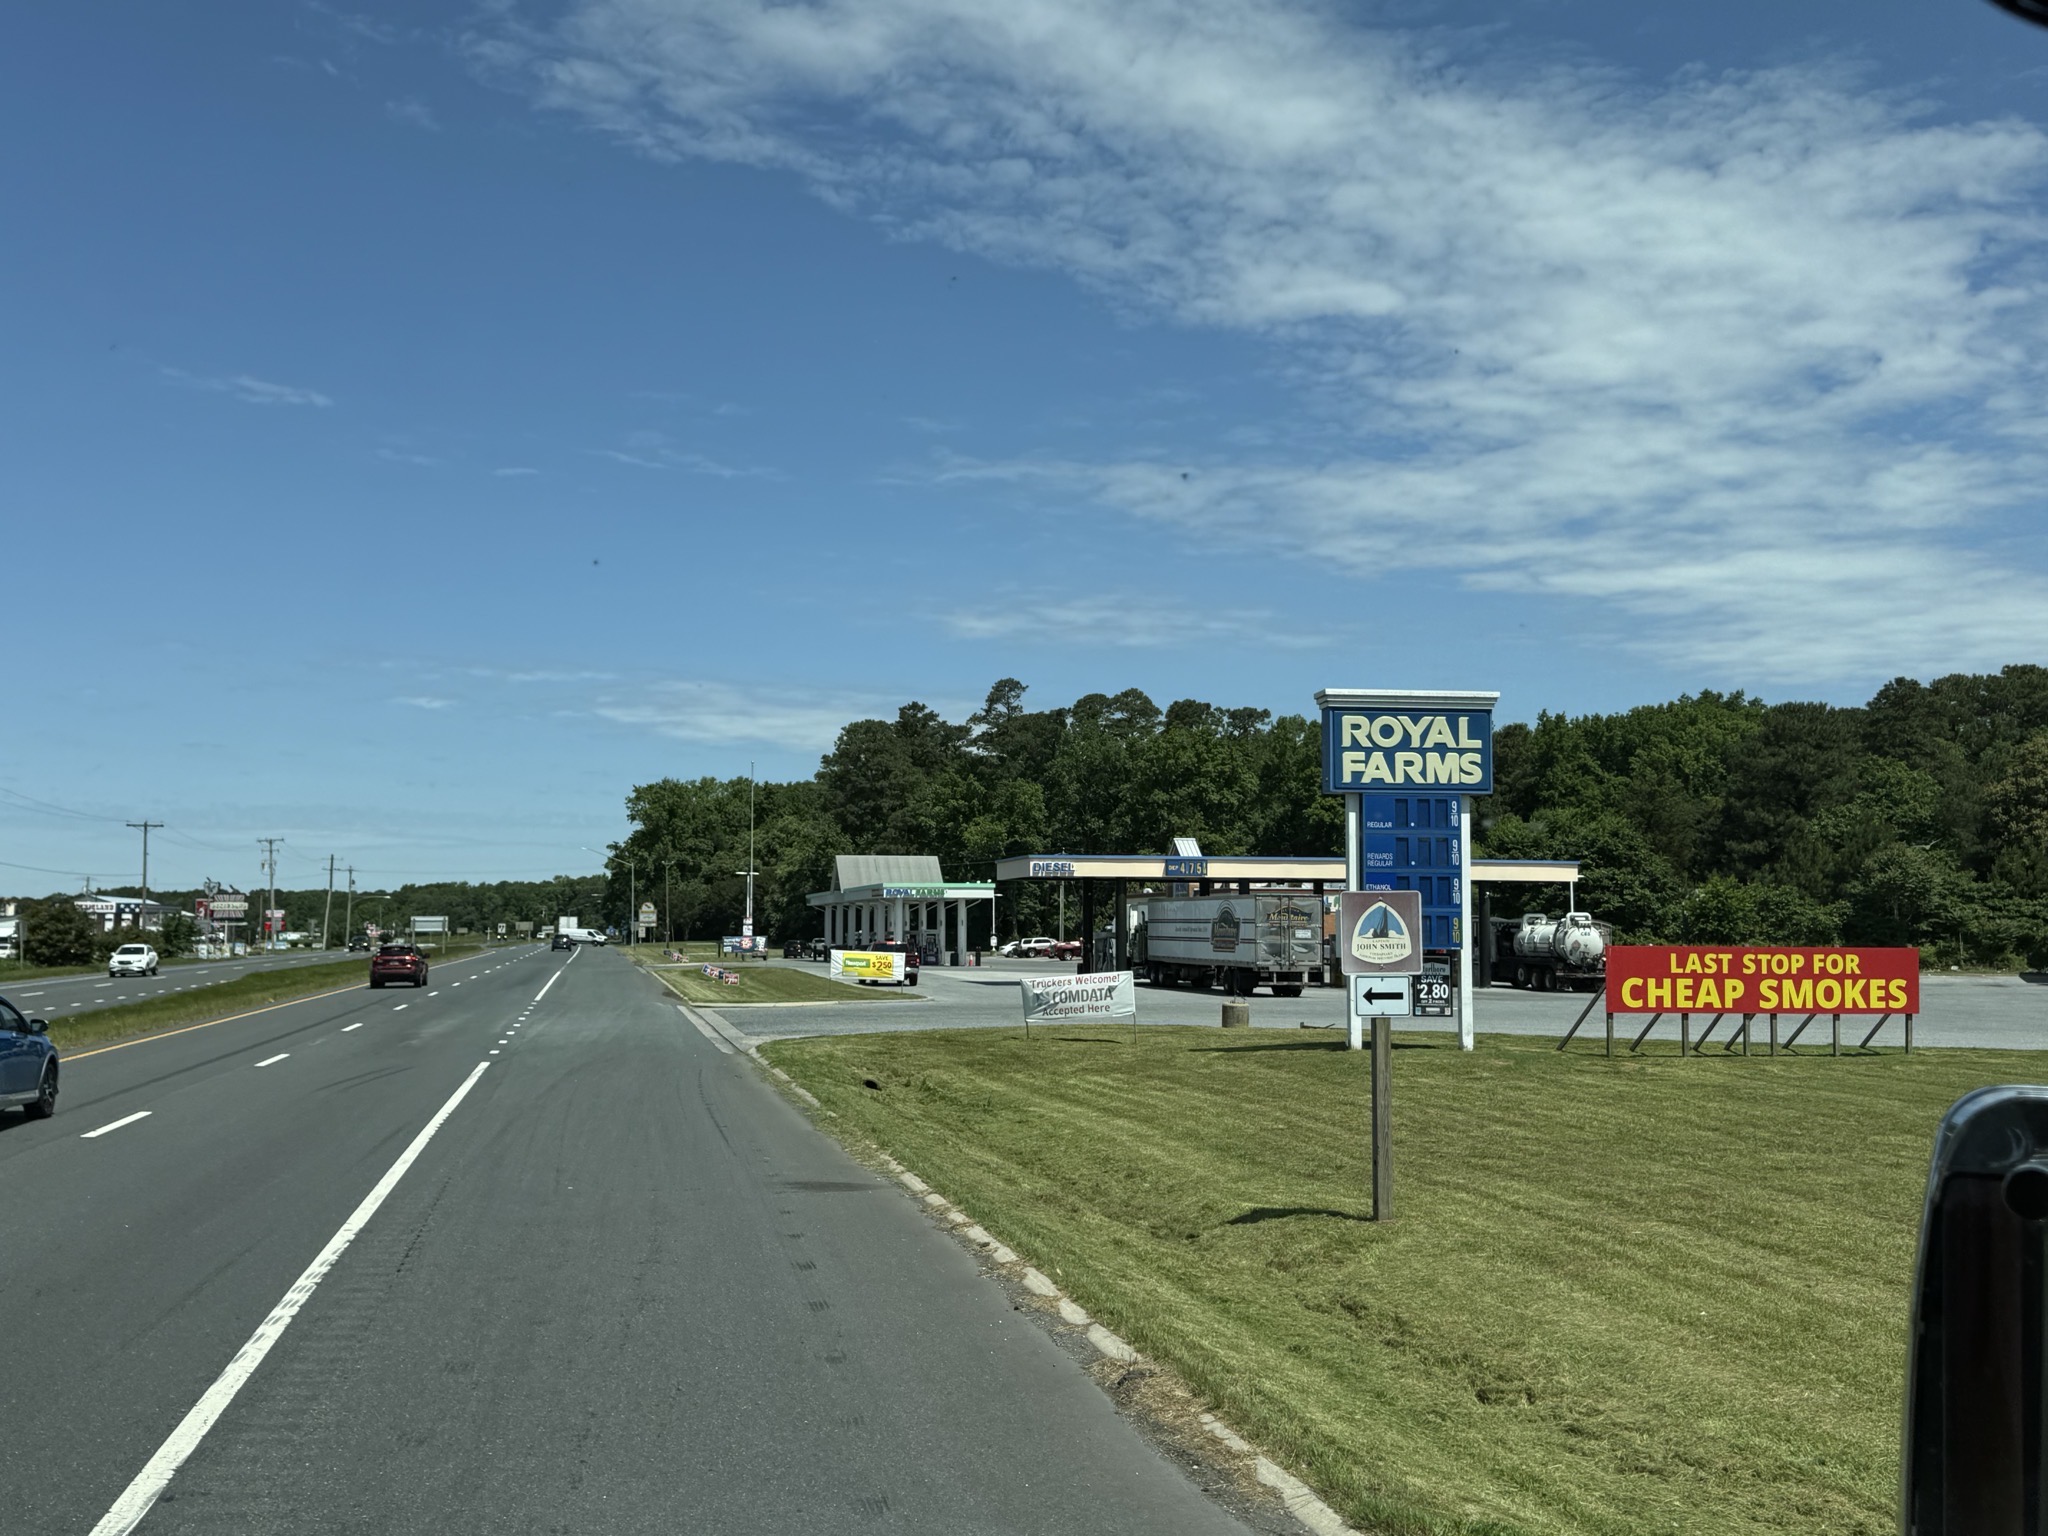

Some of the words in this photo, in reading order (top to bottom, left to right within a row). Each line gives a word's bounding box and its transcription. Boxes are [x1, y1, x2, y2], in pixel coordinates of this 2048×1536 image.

[1341, 715, 1483, 748] ROYAL
[1342, 752, 1483, 784] FARMS
[1451, 800, 1457, 813] 9
[1451, 815, 1459, 827] 10
[1452, 839, 1459, 852] 9
[1452, 854, 1460, 866] 10
[1032, 862, 1074, 872] DIESEL
[1453, 878, 1459, 890] 9
[885, 888, 911, 896] ROYAL
[1453, 892, 1460, 904] 10
[1453, 917, 1459, 930] 9
[1453, 931, 1460, 943] 10
[1357, 943, 1378, 952] JOHN
[1670, 953, 1732, 974] LAST
[1742, 953, 1804, 974] STOP
[1813, 954, 1861, 974] FOR
[1031, 979, 1072, 989] Truckers
[1075, 974, 1120, 985] Welcome!
[1421, 975, 1443, 983] SAVE
[1052, 988, 1114, 1004] COMDATA
[1417, 984, 1449, 999] $2.80
[1621, 977, 1745, 1009] CHEAP
[1759, 978, 1908, 1010] SMOKES
[1042, 1005, 1085, 1017] Accepted
[1087, 1003, 1111, 1013] Here
